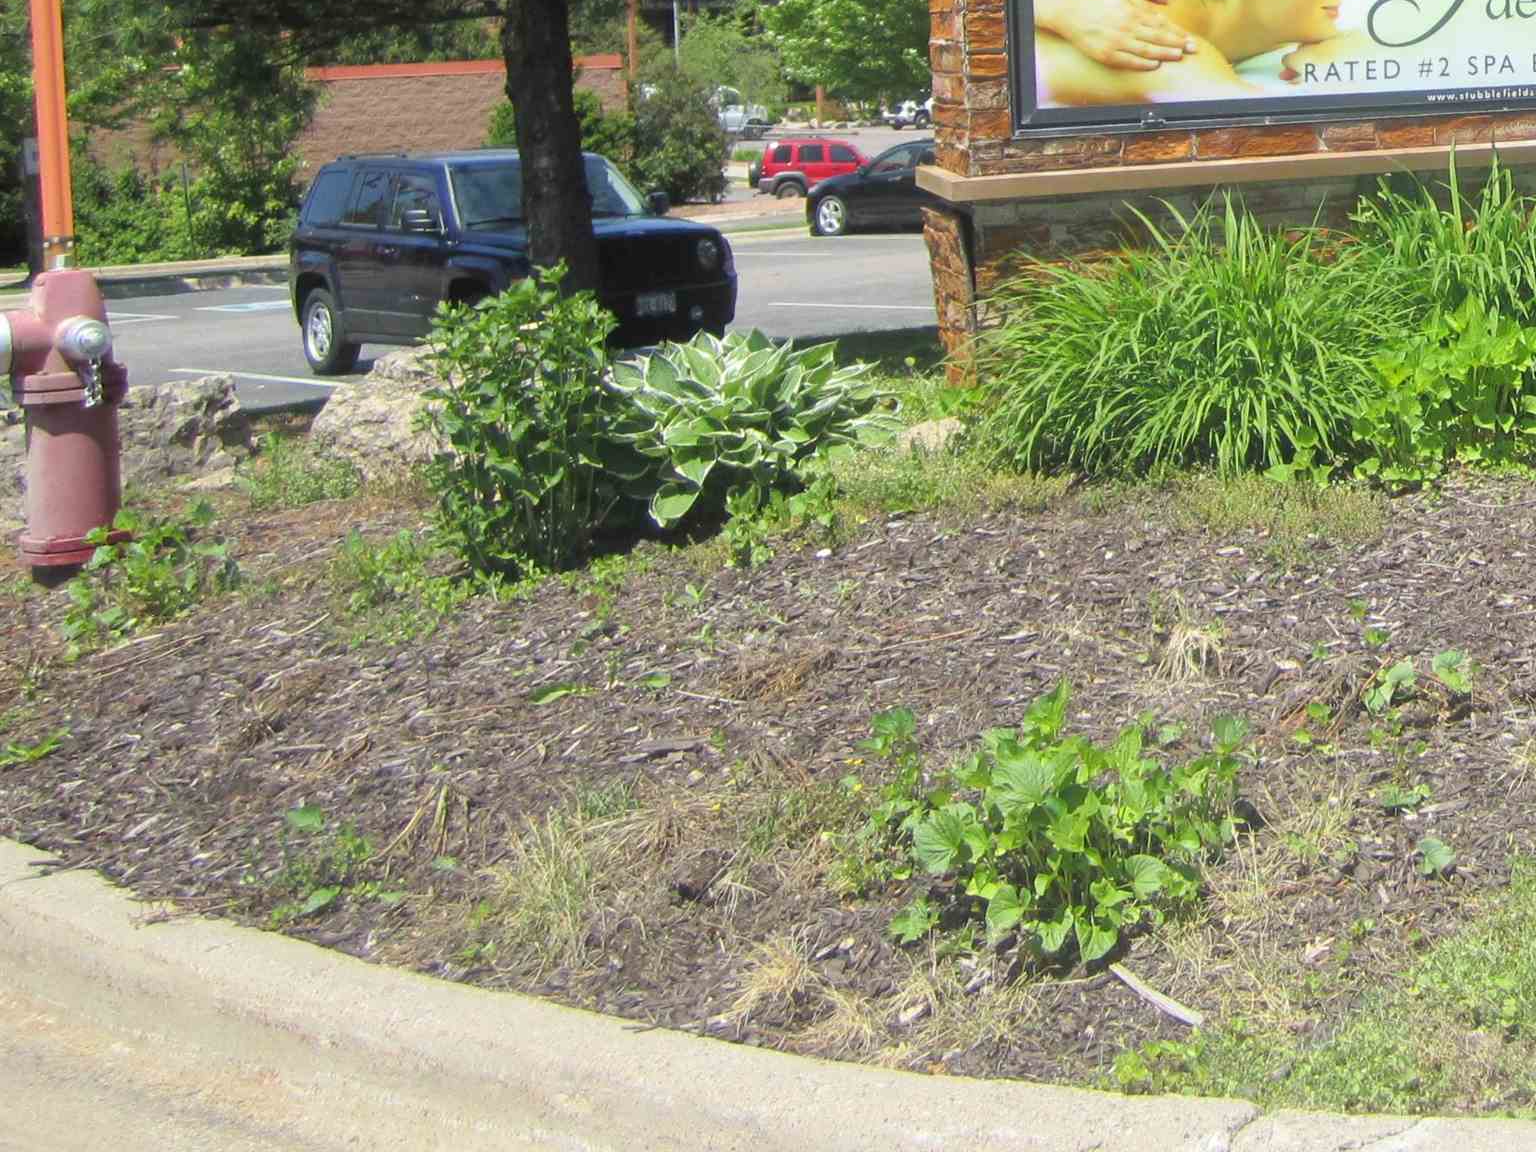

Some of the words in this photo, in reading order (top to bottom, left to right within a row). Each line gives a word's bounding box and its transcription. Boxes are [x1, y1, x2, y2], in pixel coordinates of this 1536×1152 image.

[1304, 59, 1400, 83] RATED
[1418, 57, 1450, 78] #2
[1468, 55, 1515, 75] SPA
